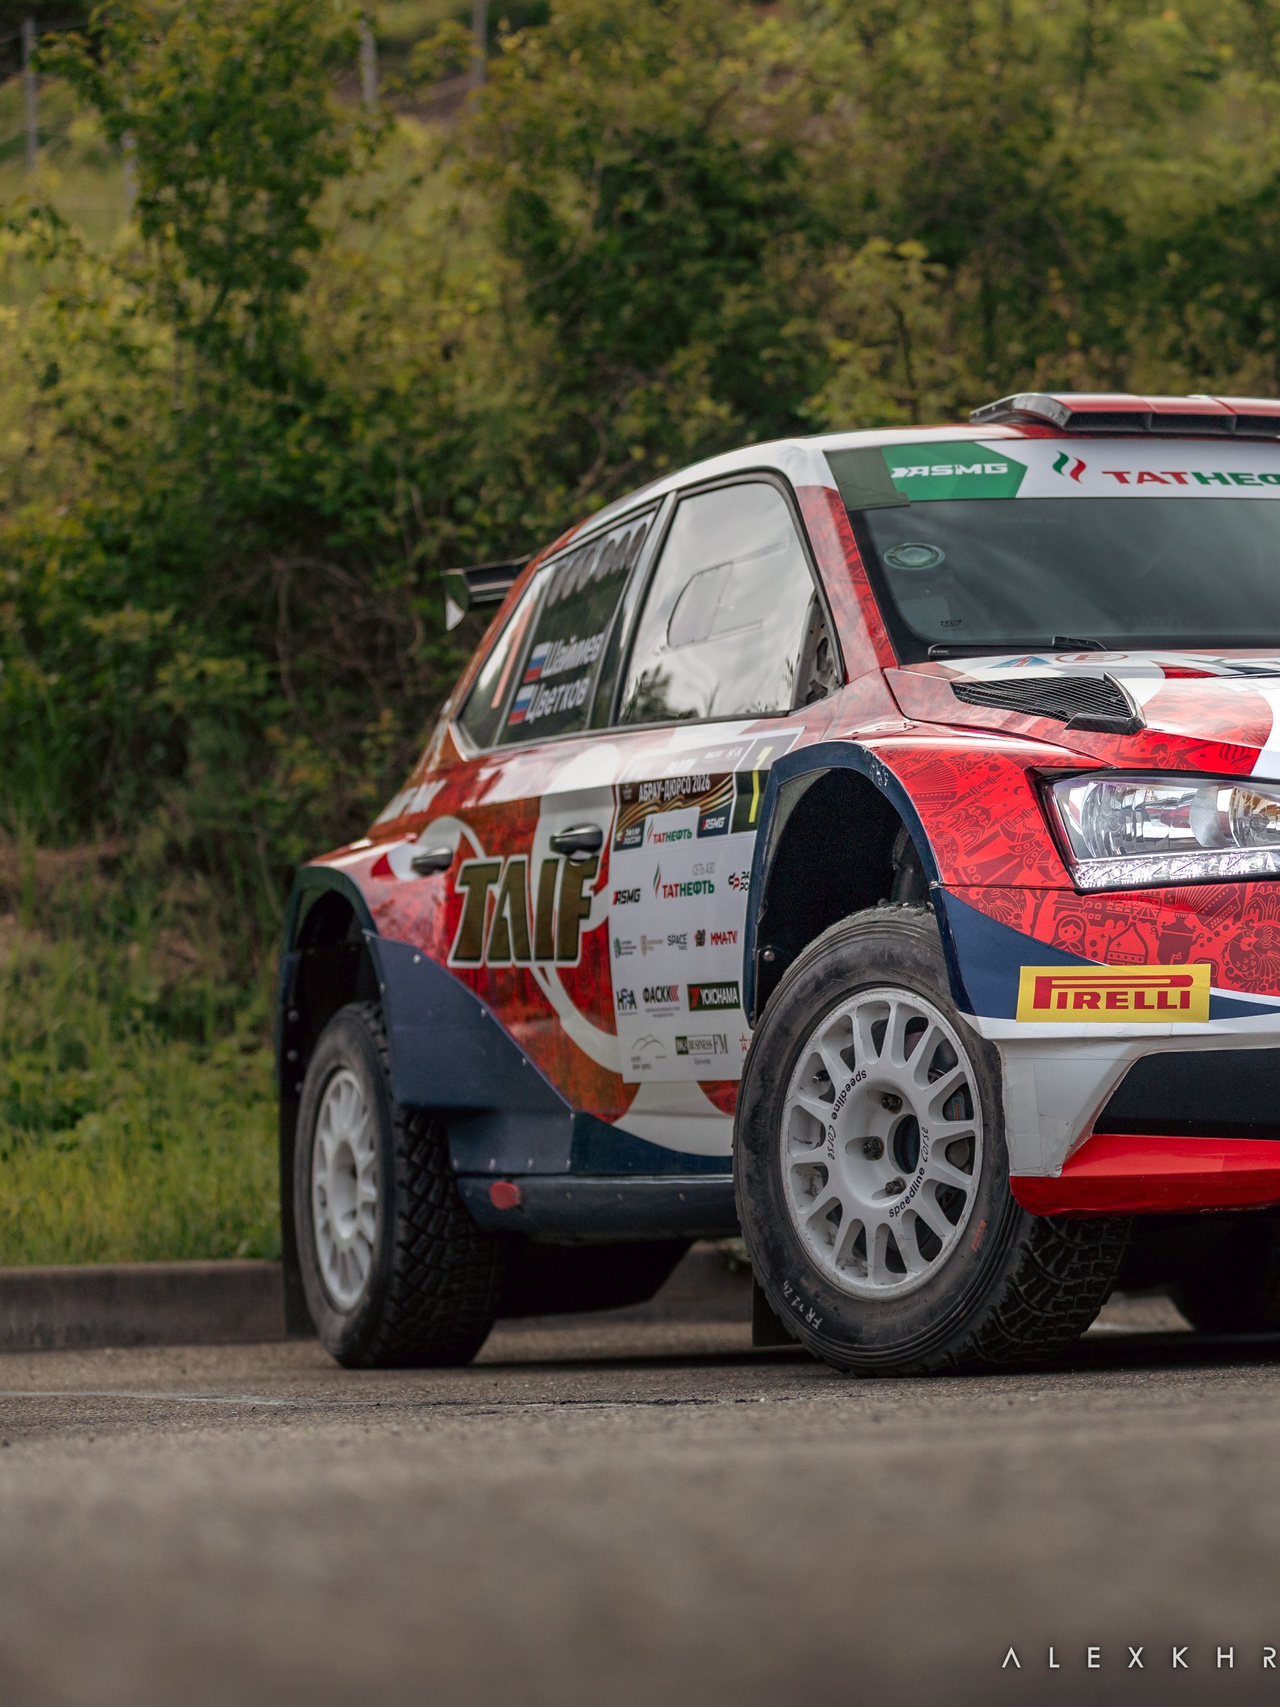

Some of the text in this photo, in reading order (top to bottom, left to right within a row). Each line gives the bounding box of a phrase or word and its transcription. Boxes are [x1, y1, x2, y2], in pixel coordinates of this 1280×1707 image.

[540, 633, 604, 678] Шаймиев
[525, 677, 589, 724] Цветков
[638, 775, 691, 802] АБРАУ-ДЮРСО
[692, 773, 711, 793] 2026
[748, 745, 774, 823] 1
[653, 828, 693, 844] ТАТНЕФТЬ
[692, 862, 716, 876] СЕТЬ АЗС
[662, 880, 715, 899] ТАТНЕФТЬ
[447, 854, 600, 968] TAIF
[700, 987, 739, 1005] YOKOHAMA
[1033, 975, 1194, 1009] PIRELLI
[688, 1039, 713, 1051] BUSINESS
[712, 1034, 729, 1054] FM
[831, 1069, 867, 1120] speedline
[888, 1167, 925, 1218] speedline
